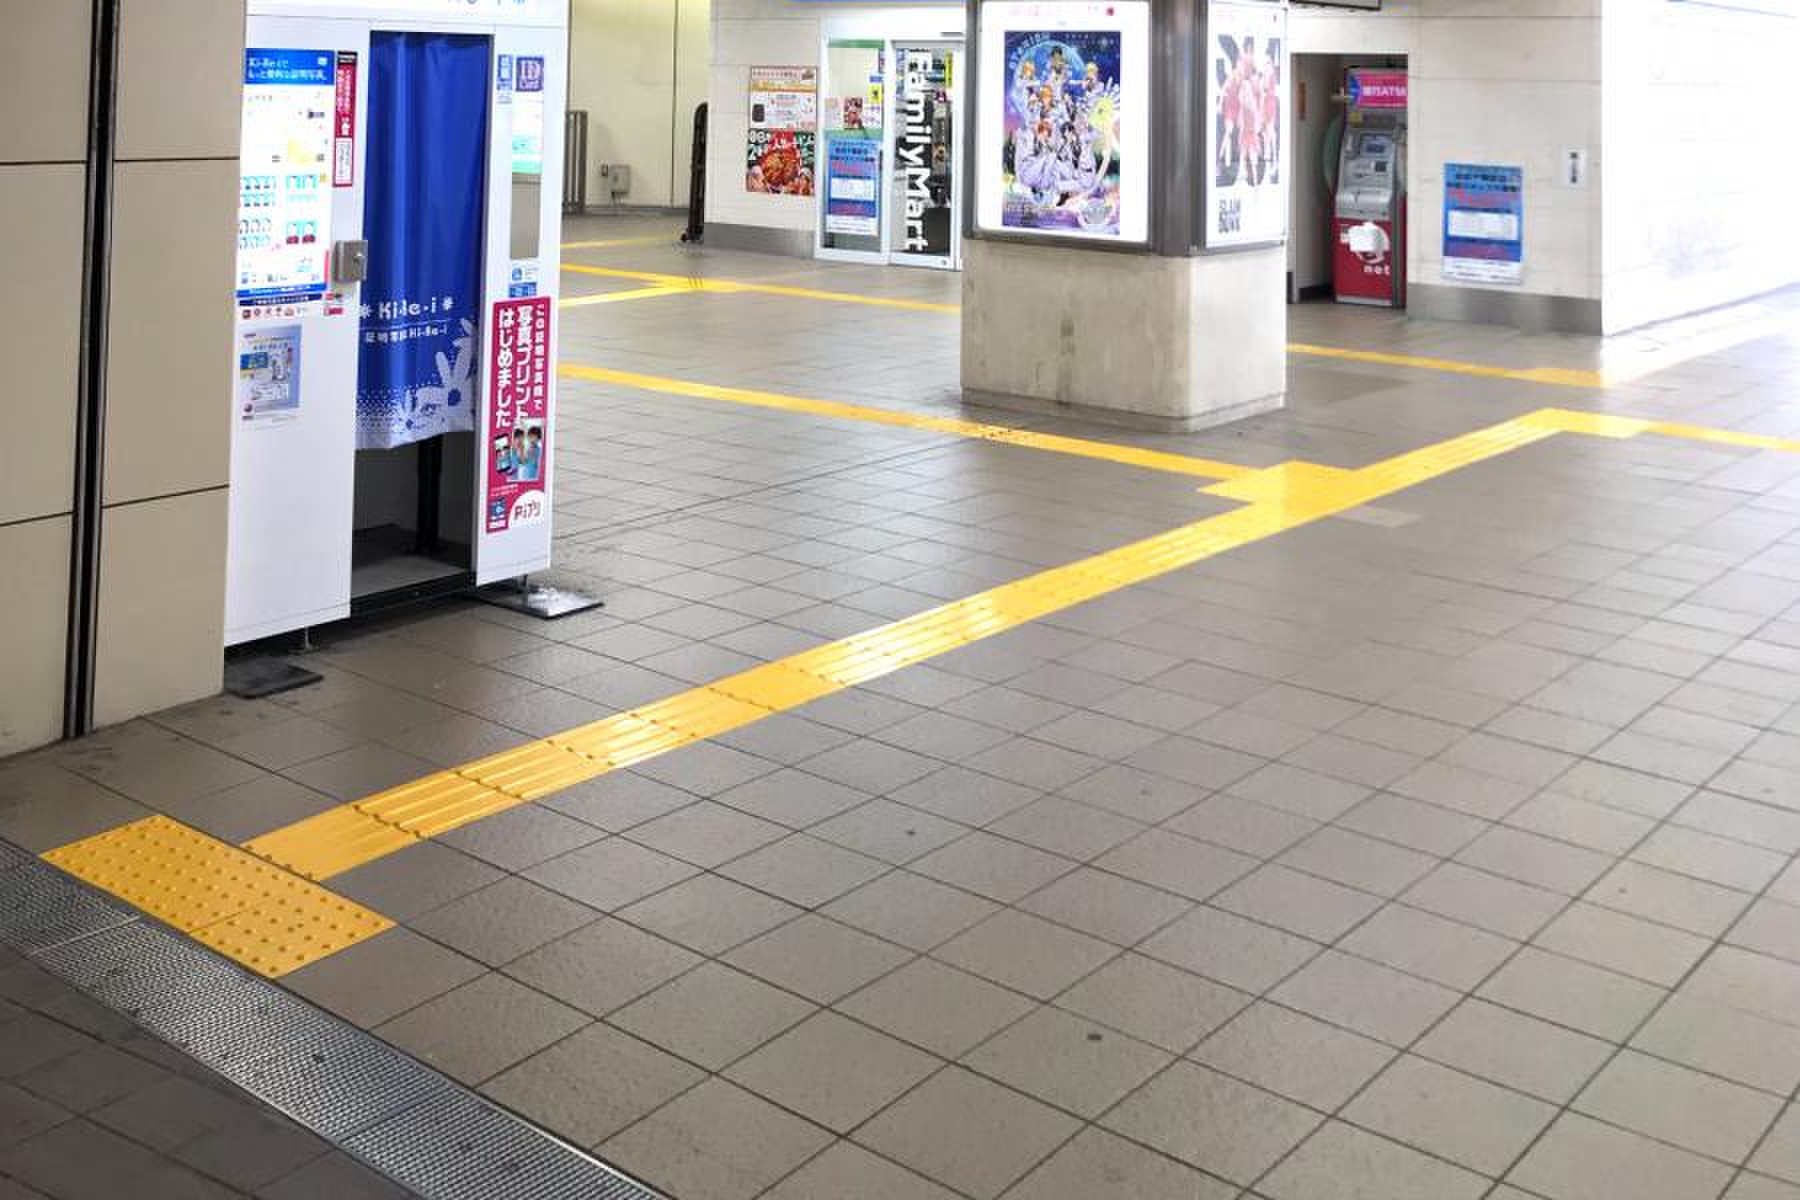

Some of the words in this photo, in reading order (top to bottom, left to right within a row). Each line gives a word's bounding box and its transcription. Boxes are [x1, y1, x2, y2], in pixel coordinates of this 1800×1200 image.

[899, 50, 934, 252] FamilyMart
[495, 308, 515, 429] はじめました
